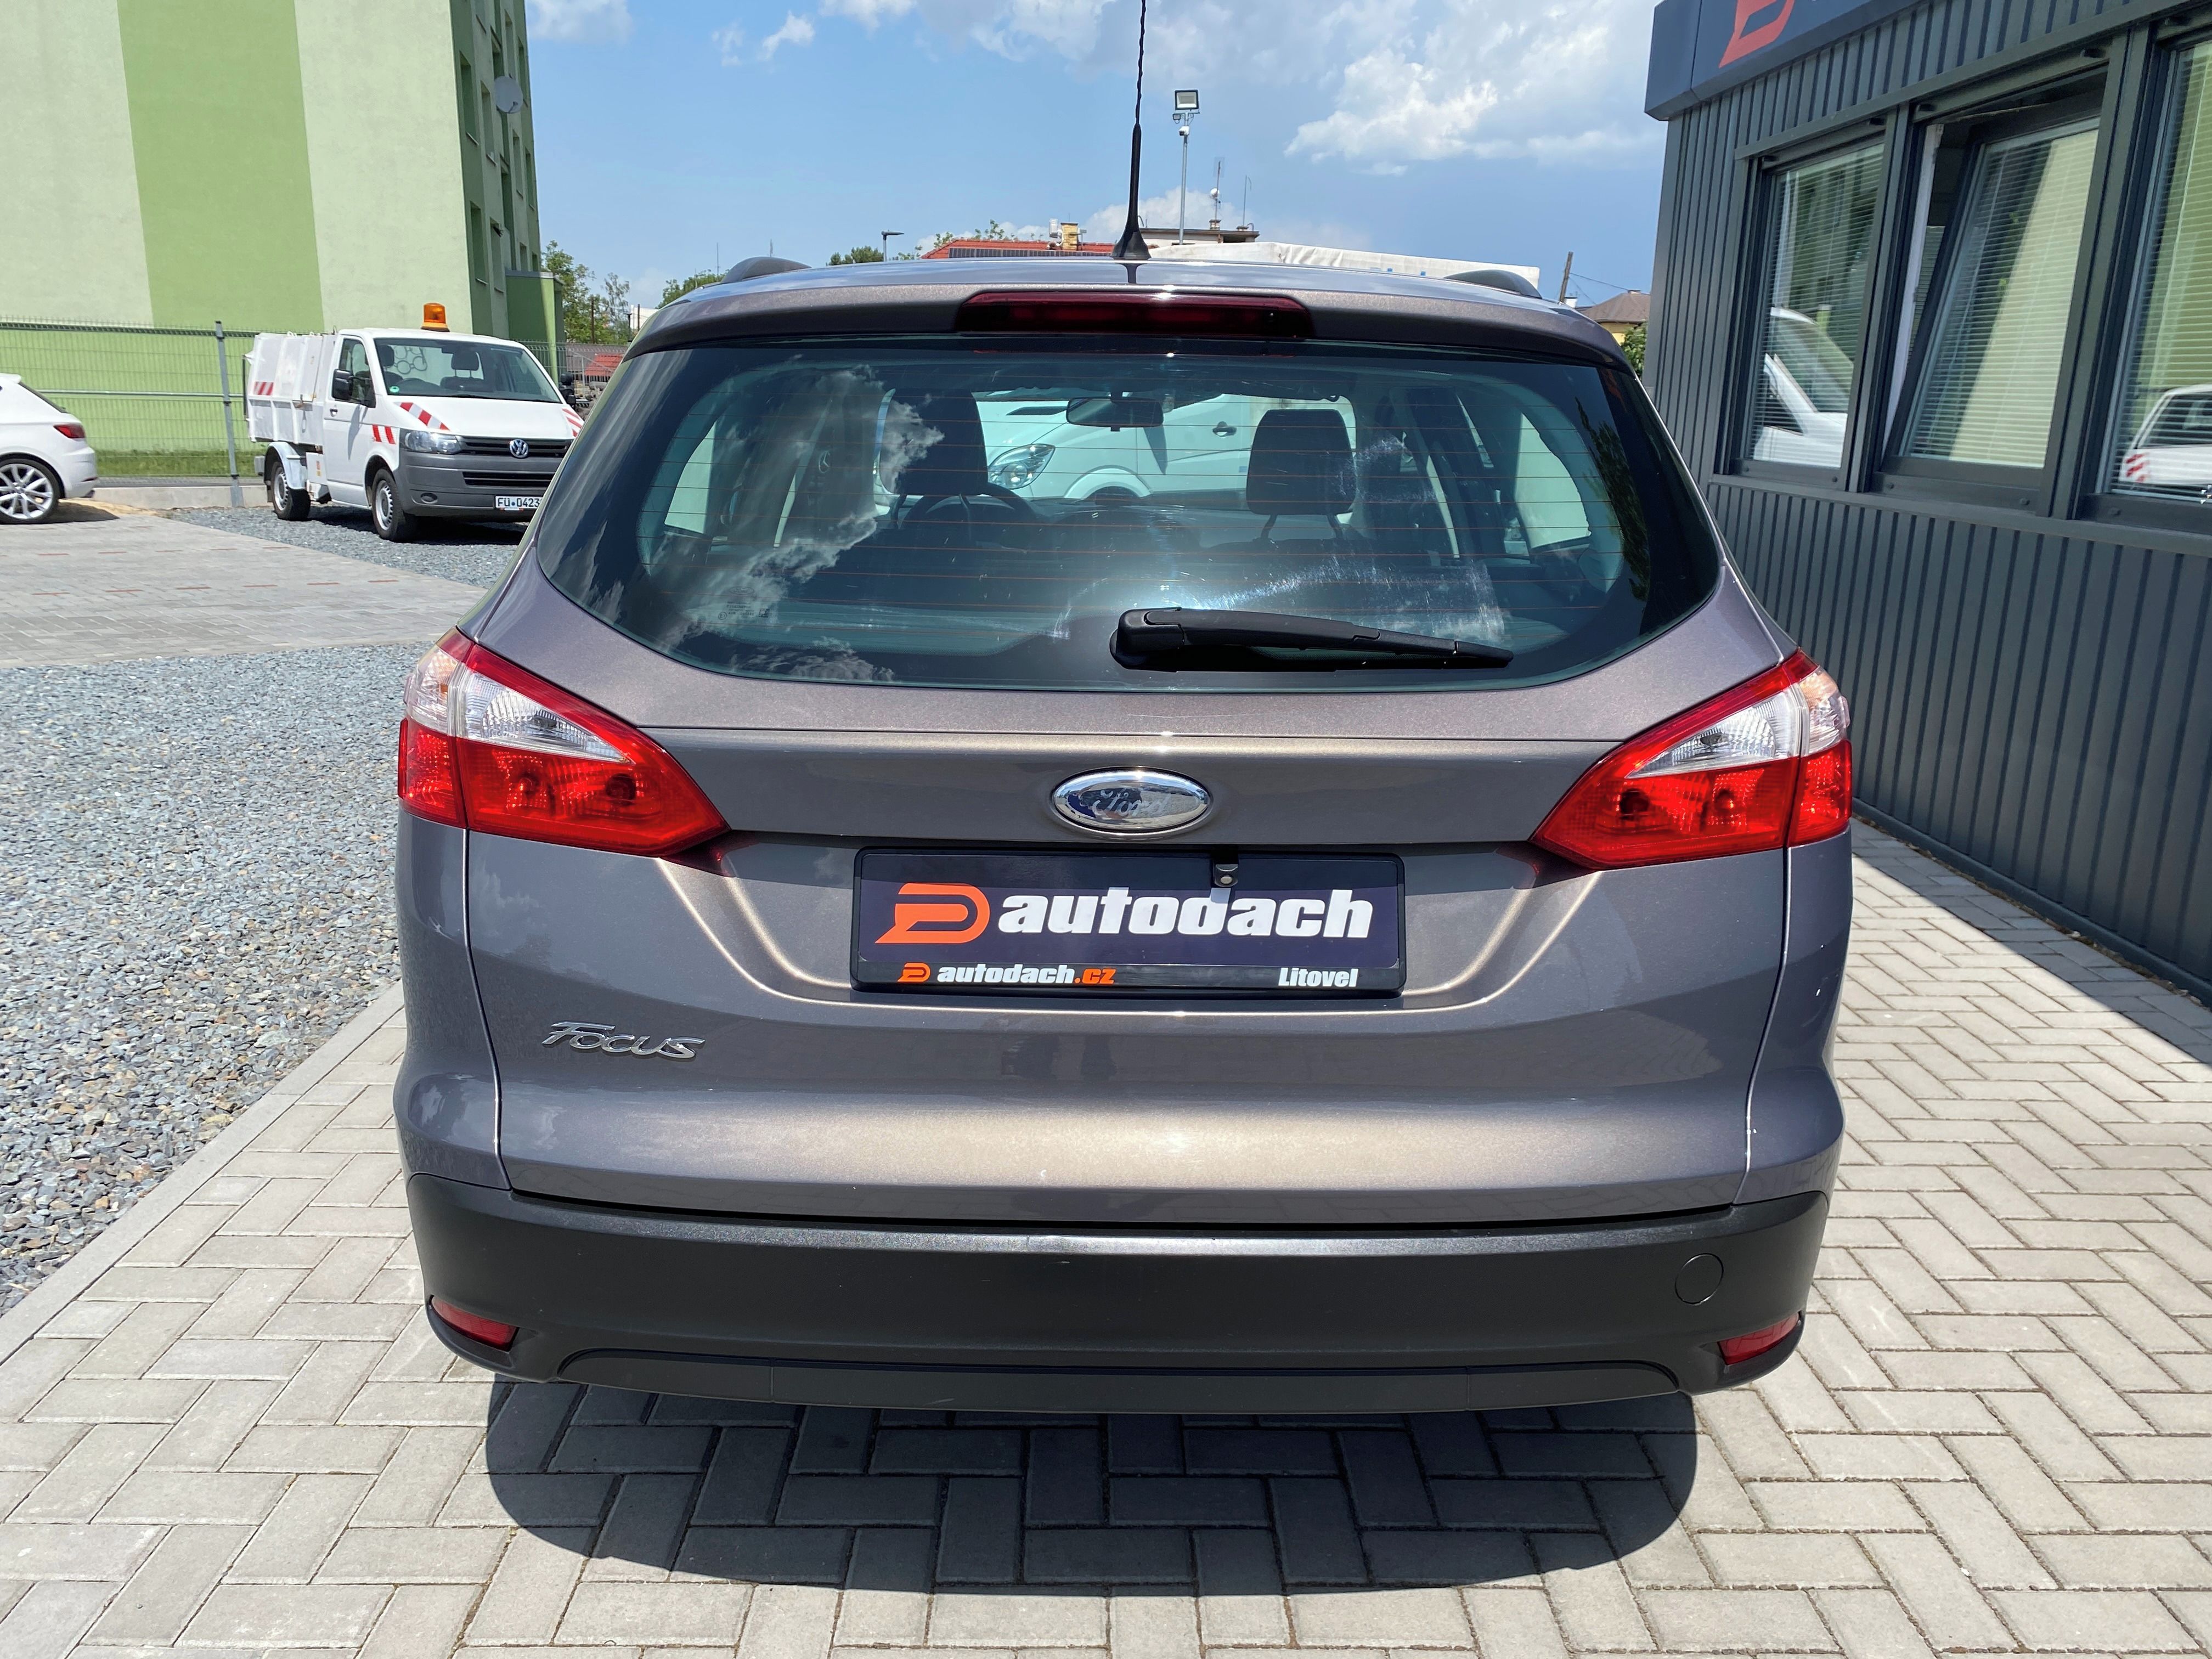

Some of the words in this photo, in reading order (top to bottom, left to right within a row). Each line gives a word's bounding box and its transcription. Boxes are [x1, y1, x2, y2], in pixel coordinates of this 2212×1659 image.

[517, 498, 543, 507] 0423
[998, 887, 1373, 938] autodach
[937, 963, 1116, 985] autodach.cz
[1278, 967, 1359, 988] Litovel
